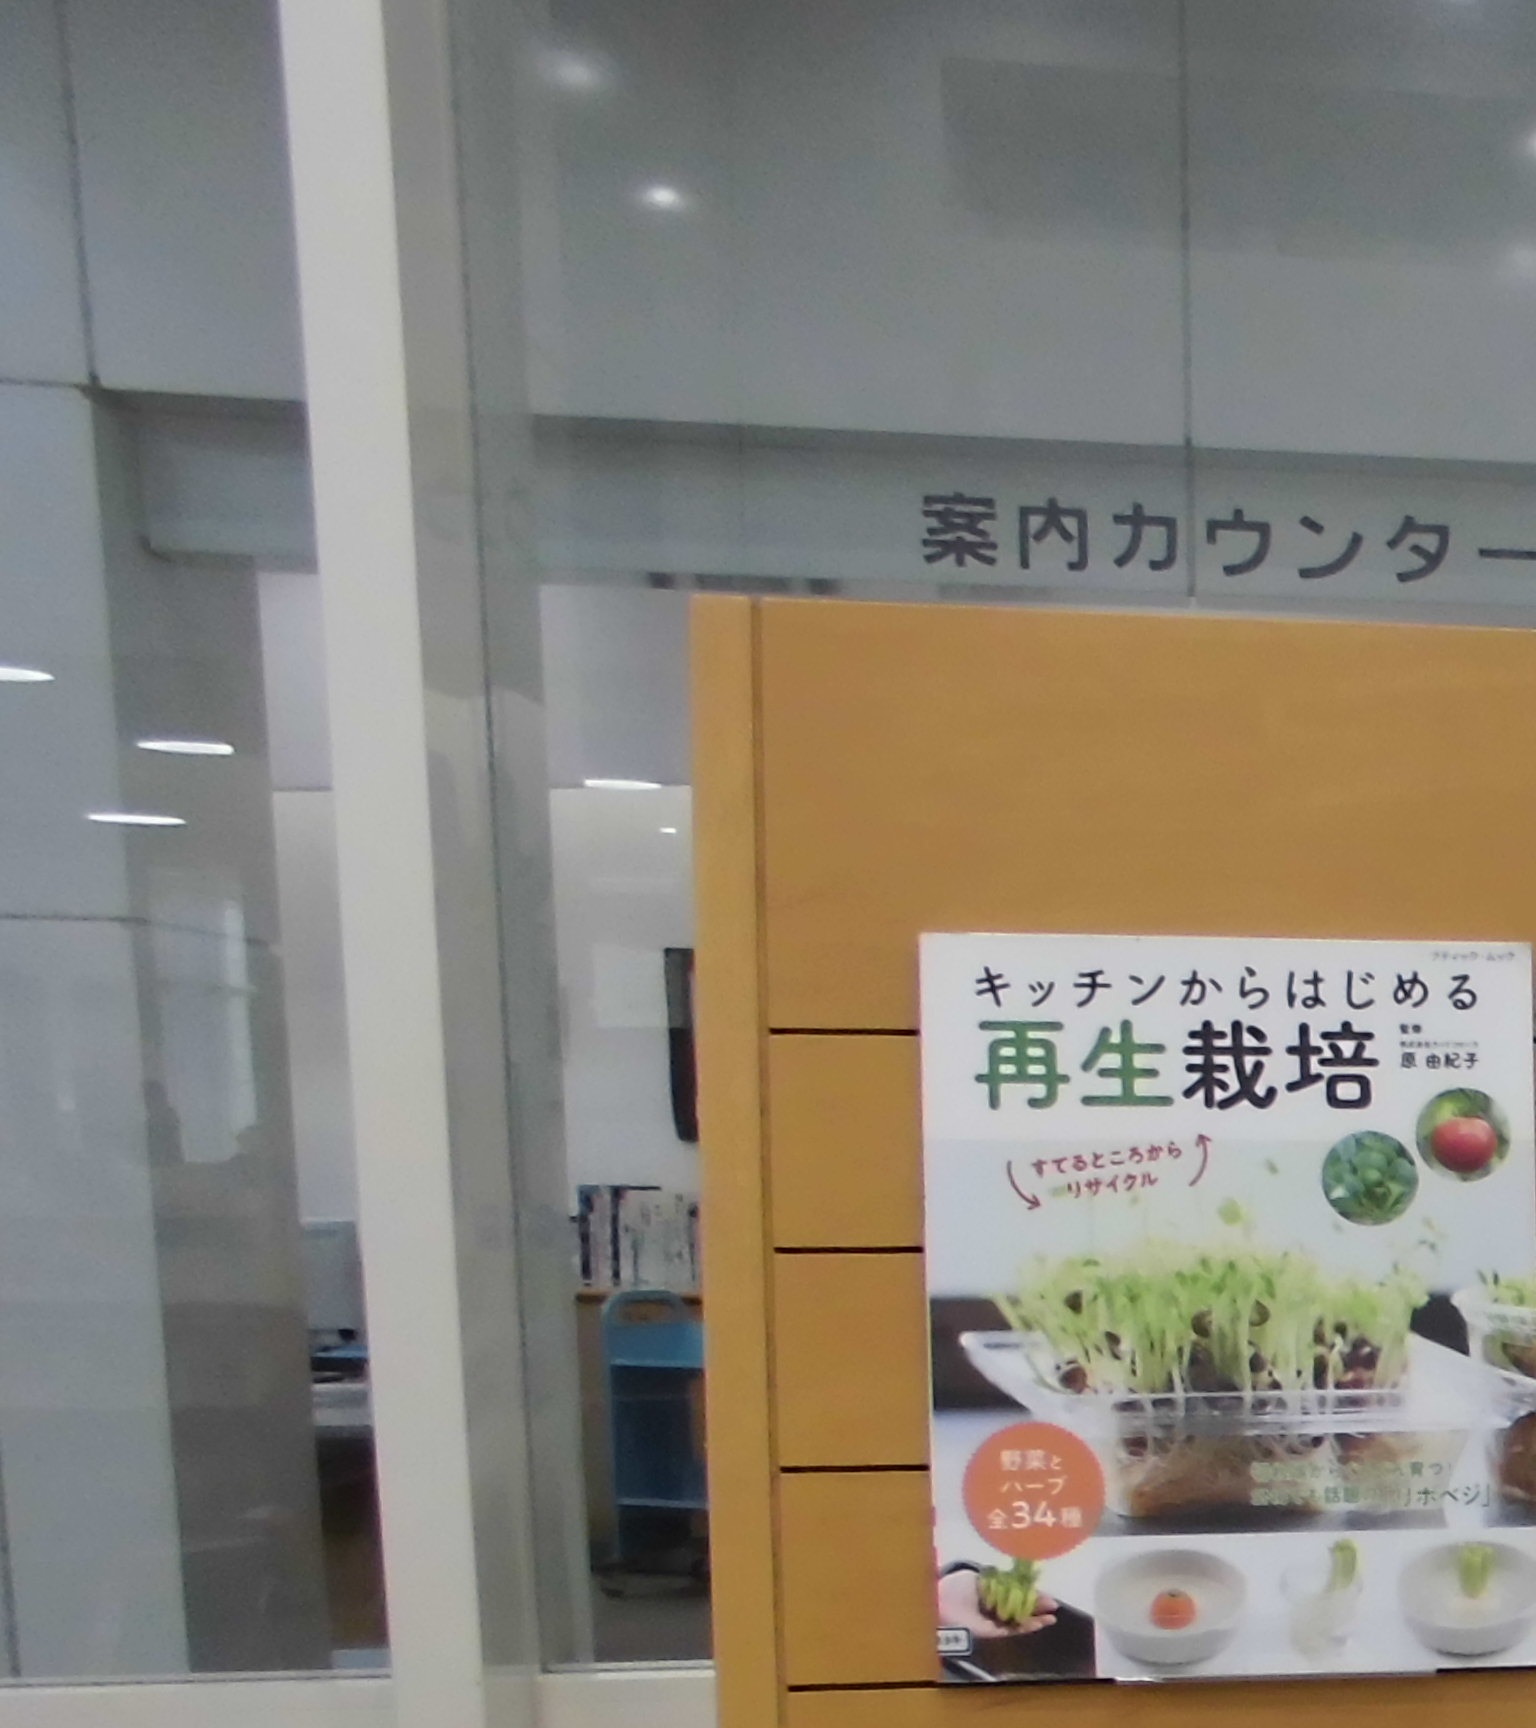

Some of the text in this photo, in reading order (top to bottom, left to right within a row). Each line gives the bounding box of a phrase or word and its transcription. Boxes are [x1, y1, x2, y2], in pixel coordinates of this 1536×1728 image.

[974, 966, 1478, 1009] キッチンからはじめる
[974, 1019, 1379, 1111] 再生栽培
[1031, 1140, 1183, 1176] すてるところから
[1066, 1172, 1158, 1198] リサイクル
[1000, 1449, 1063, 1472] 野菜と
[987, 1500, 1084, 1531] 全34種
